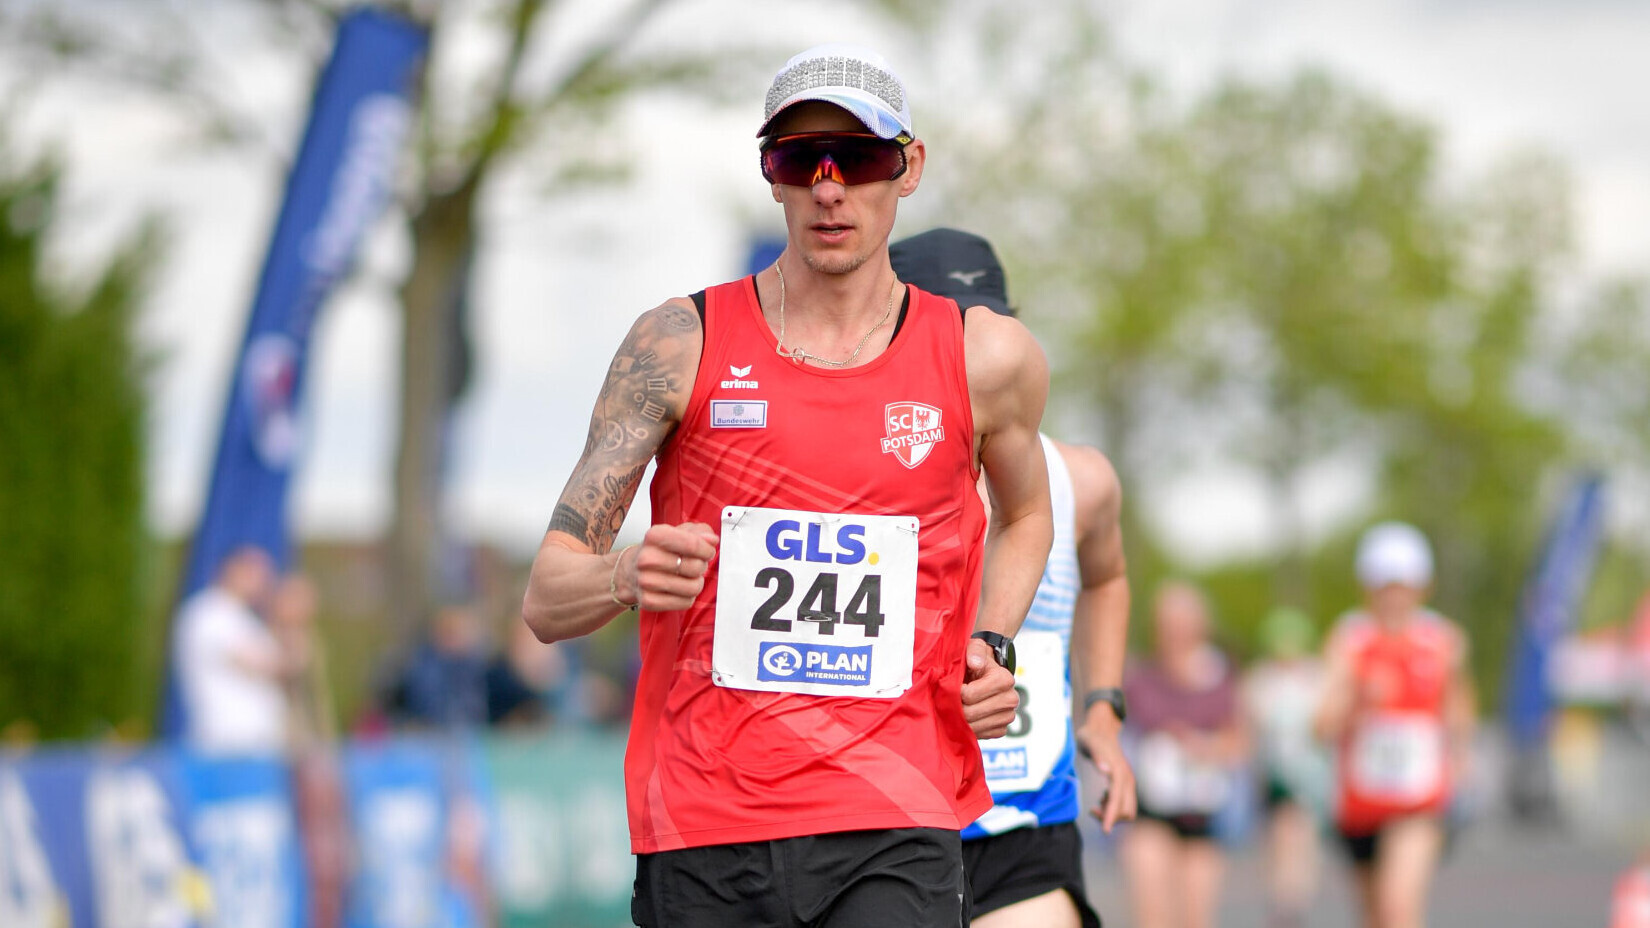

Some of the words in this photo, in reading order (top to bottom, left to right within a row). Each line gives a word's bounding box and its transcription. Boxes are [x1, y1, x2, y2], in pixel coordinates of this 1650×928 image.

[721, 379, 759, 389] erima
[889, 413, 912, 432] SC
[883, 428, 942, 451] POTSDAM
[765, 519, 880, 566] GLS.
[750, 567, 885, 638] 244
[806, 650, 868, 672] PLAN
[805, 671, 867, 681] INTERNATIONAL
[982, 751, 1025, 768] LAN
